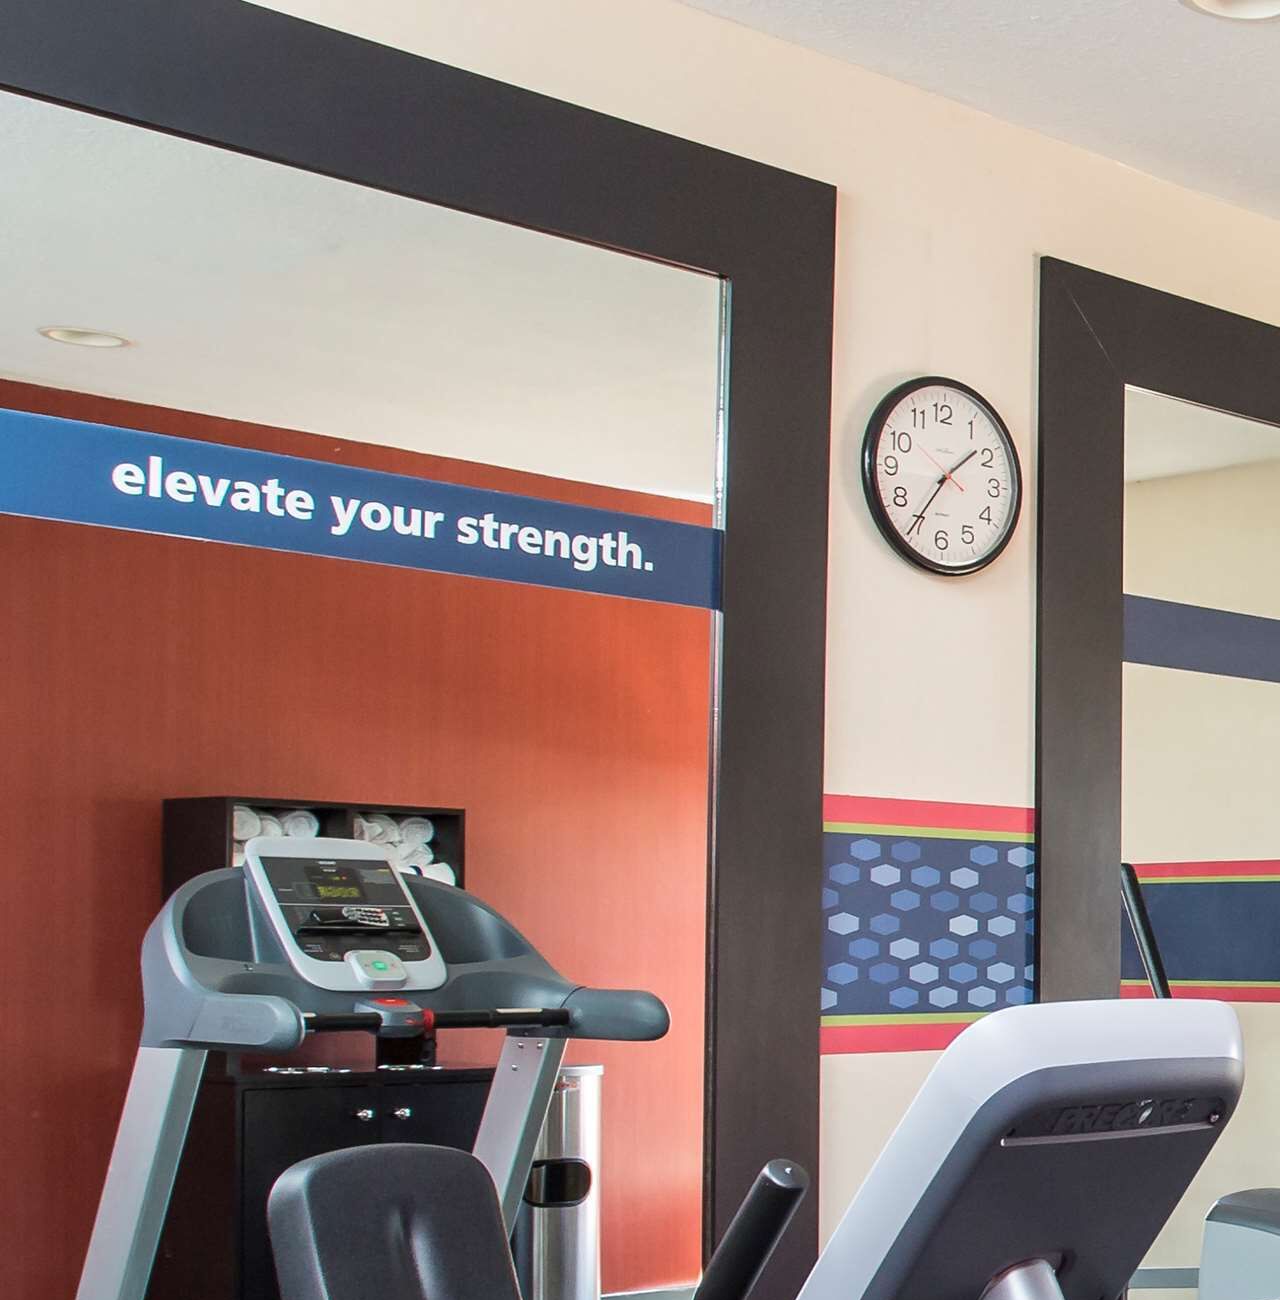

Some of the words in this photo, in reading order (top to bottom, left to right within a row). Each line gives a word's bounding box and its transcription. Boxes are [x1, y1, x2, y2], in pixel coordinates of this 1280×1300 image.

[911, 407, 926, 430] 11
[932, 402, 953, 426] 12
[967, 420, 974, 440] 1
[890, 430, 912, 453] 10
[884, 455, 898, 476] 9
[981, 448, 994, 468] 2
[893, 486, 908, 507] 8
[987, 478, 1000, 498] 3
[111, 456, 315, 520] elevate
[330, 494, 445, 539] your
[456, 511, 654, 572] strength.
[912, 514, 925, 535] 7
[979, 505, 993, 525] 4
[934, 530, 949, 550] 6
[961, 525, 975, 545] 5
